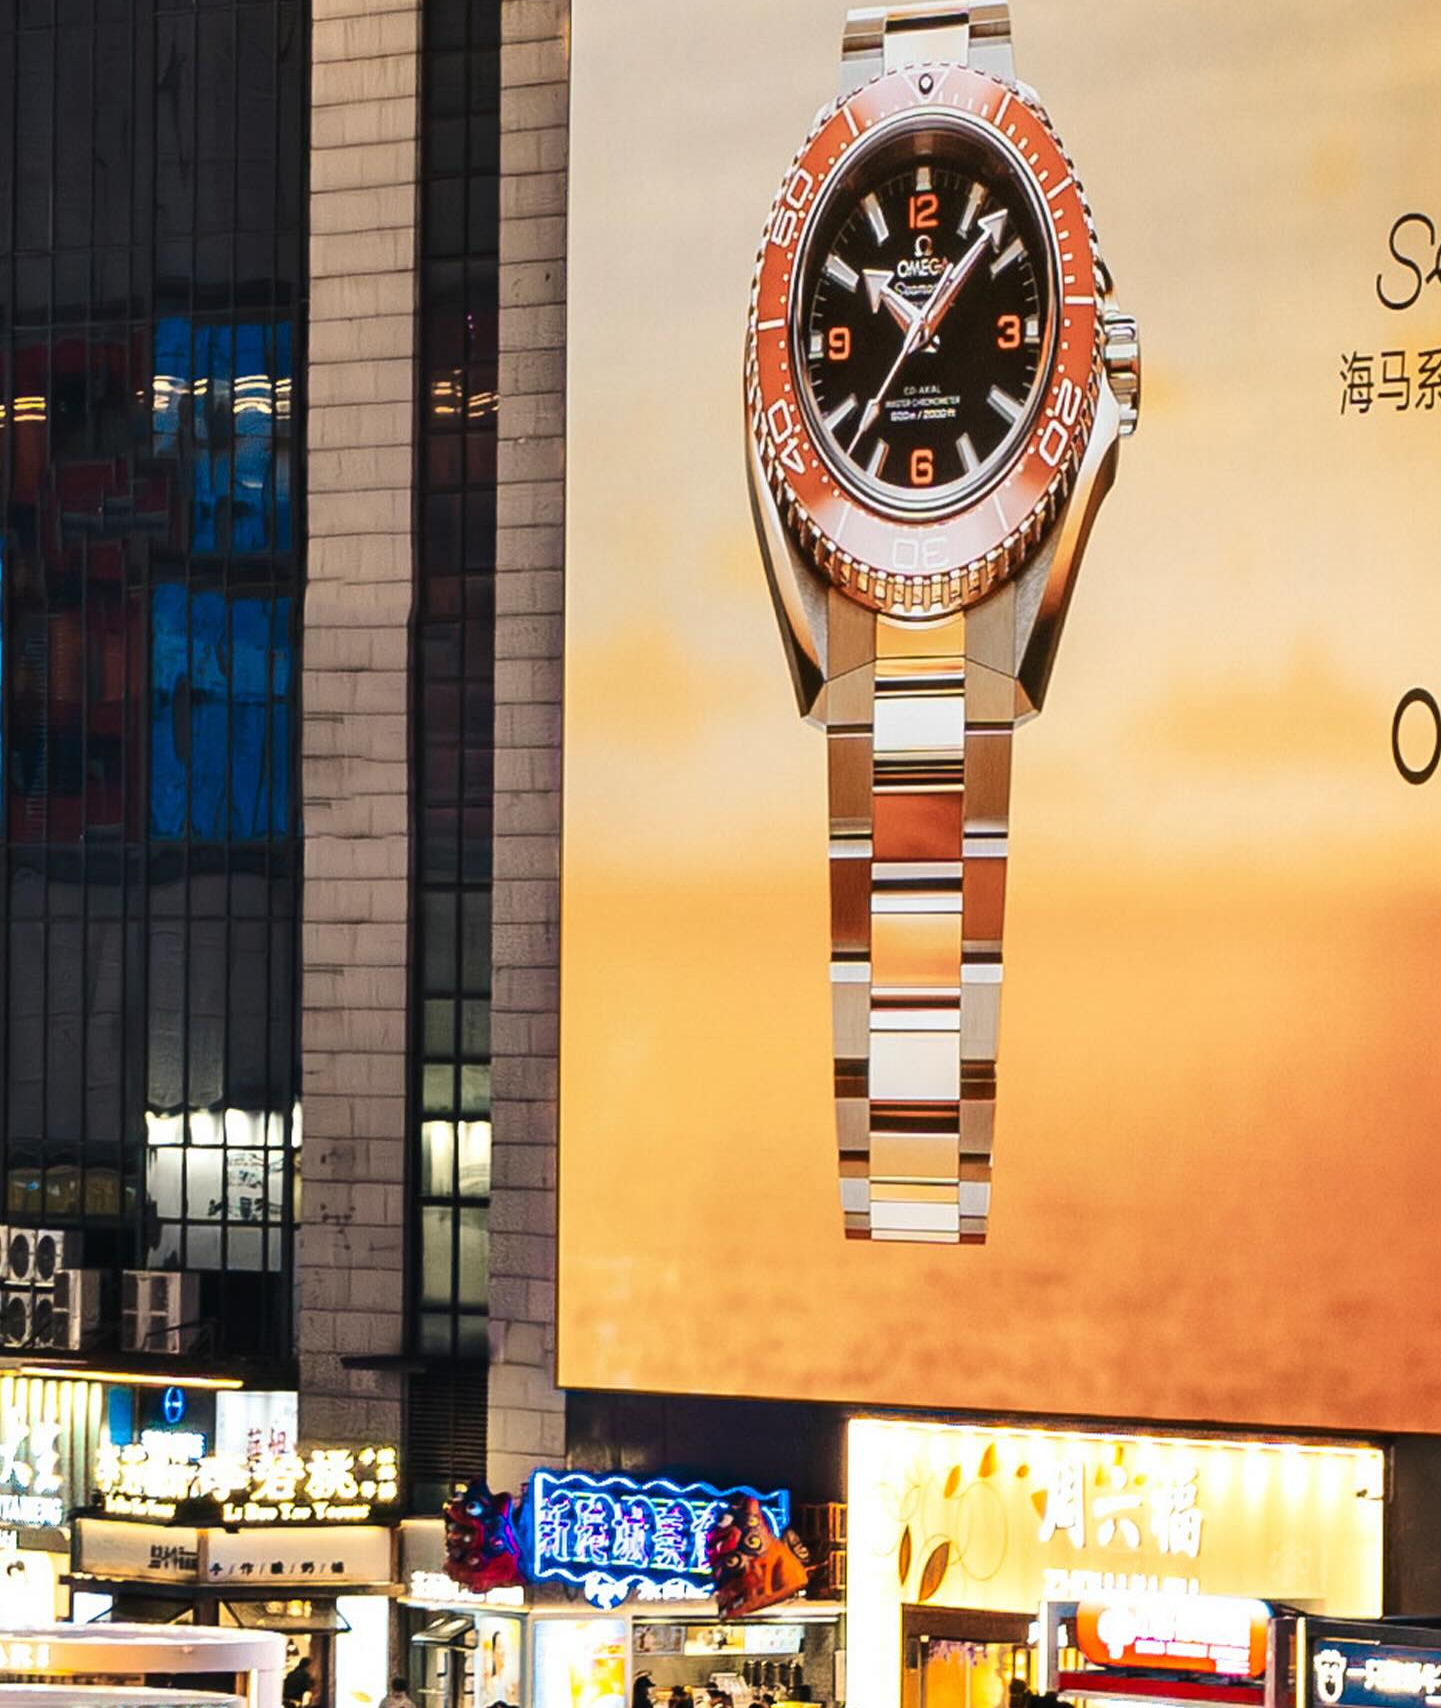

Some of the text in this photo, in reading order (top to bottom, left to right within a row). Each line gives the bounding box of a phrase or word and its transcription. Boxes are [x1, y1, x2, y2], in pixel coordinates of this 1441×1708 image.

[909, 193, 939, 229] 12
[827, 326, 851, 361] 9
[996, 315, 1021, 350] 3
[910, 448, 934, 486] 6
[1037, 1459, 1205, 1558] 周六福
